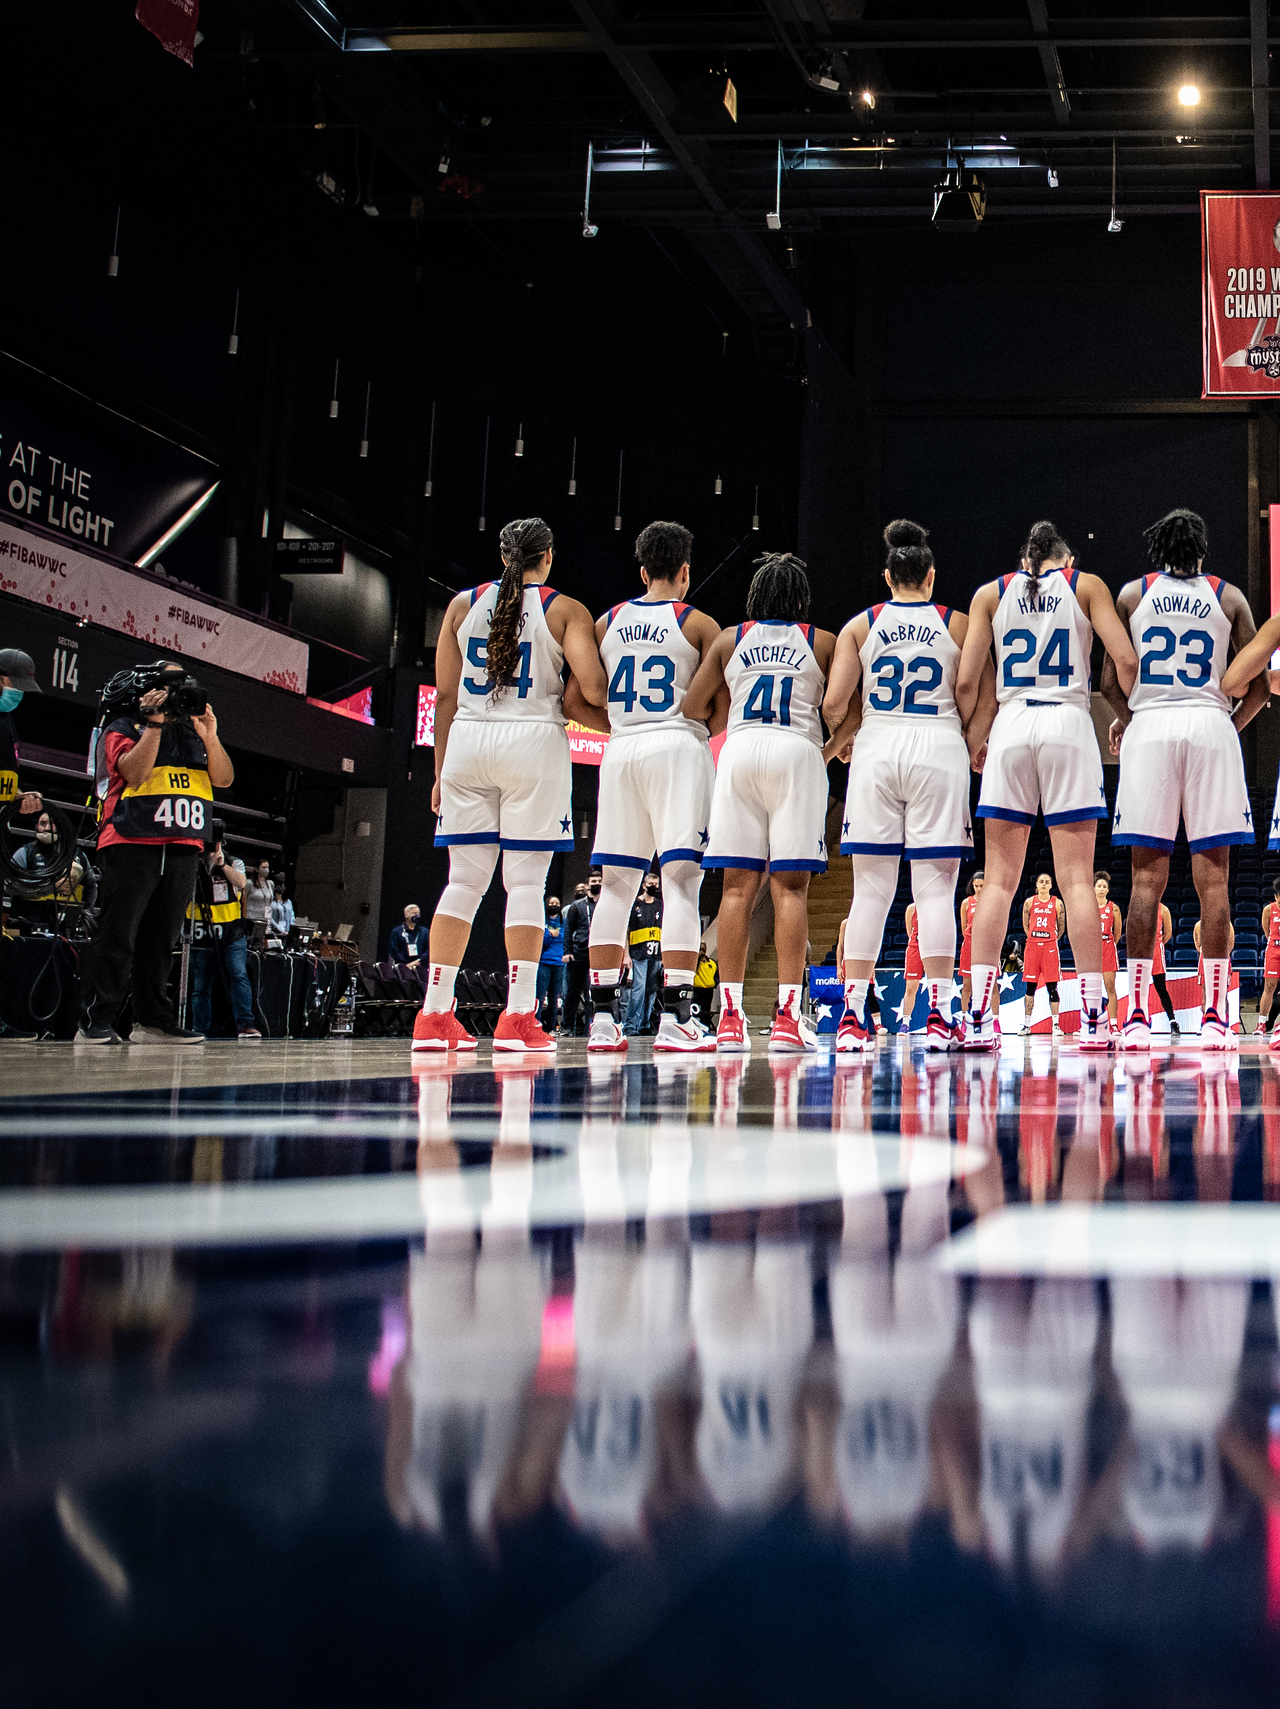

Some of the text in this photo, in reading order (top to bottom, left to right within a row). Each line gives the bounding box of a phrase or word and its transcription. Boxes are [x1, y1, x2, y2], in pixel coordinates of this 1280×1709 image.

[1227, 267, 1266, 292] 2019
[9, 441, 41, 476] AT
[48, 456, 91, 501] THE
[8, 479, 114, 546] OF LIGHT
[0, 540, 67, 578] #FIBAWWC
[168, 605, 220, 636] #FIBAWWC
[1017, 596, 1062, 616] HAMBY
[1152, 596, 1212, 619] HOWARD
[58, 636, 79, 649] SECTION
[617, 624, 669, 645] THOMAS
[878, 624, 942, 648] McBRIDE
[52, 647, 79, 692] 114
[739, 647, 807, 671] MITCHELL
[1002, 628, 1074, 687] 24
[1140, 626, 1214, 688] 23
[608, 655, 676, 713] 43
[869, 656, 943, 715] 32
[743, 674, 794, 726] 41
[569, 738, 602, 754] ALIFYING
[168, 773, 190, 789] HB
[154, 798, 205, 830] 408
[1036, 917, 1048, 928] 24
